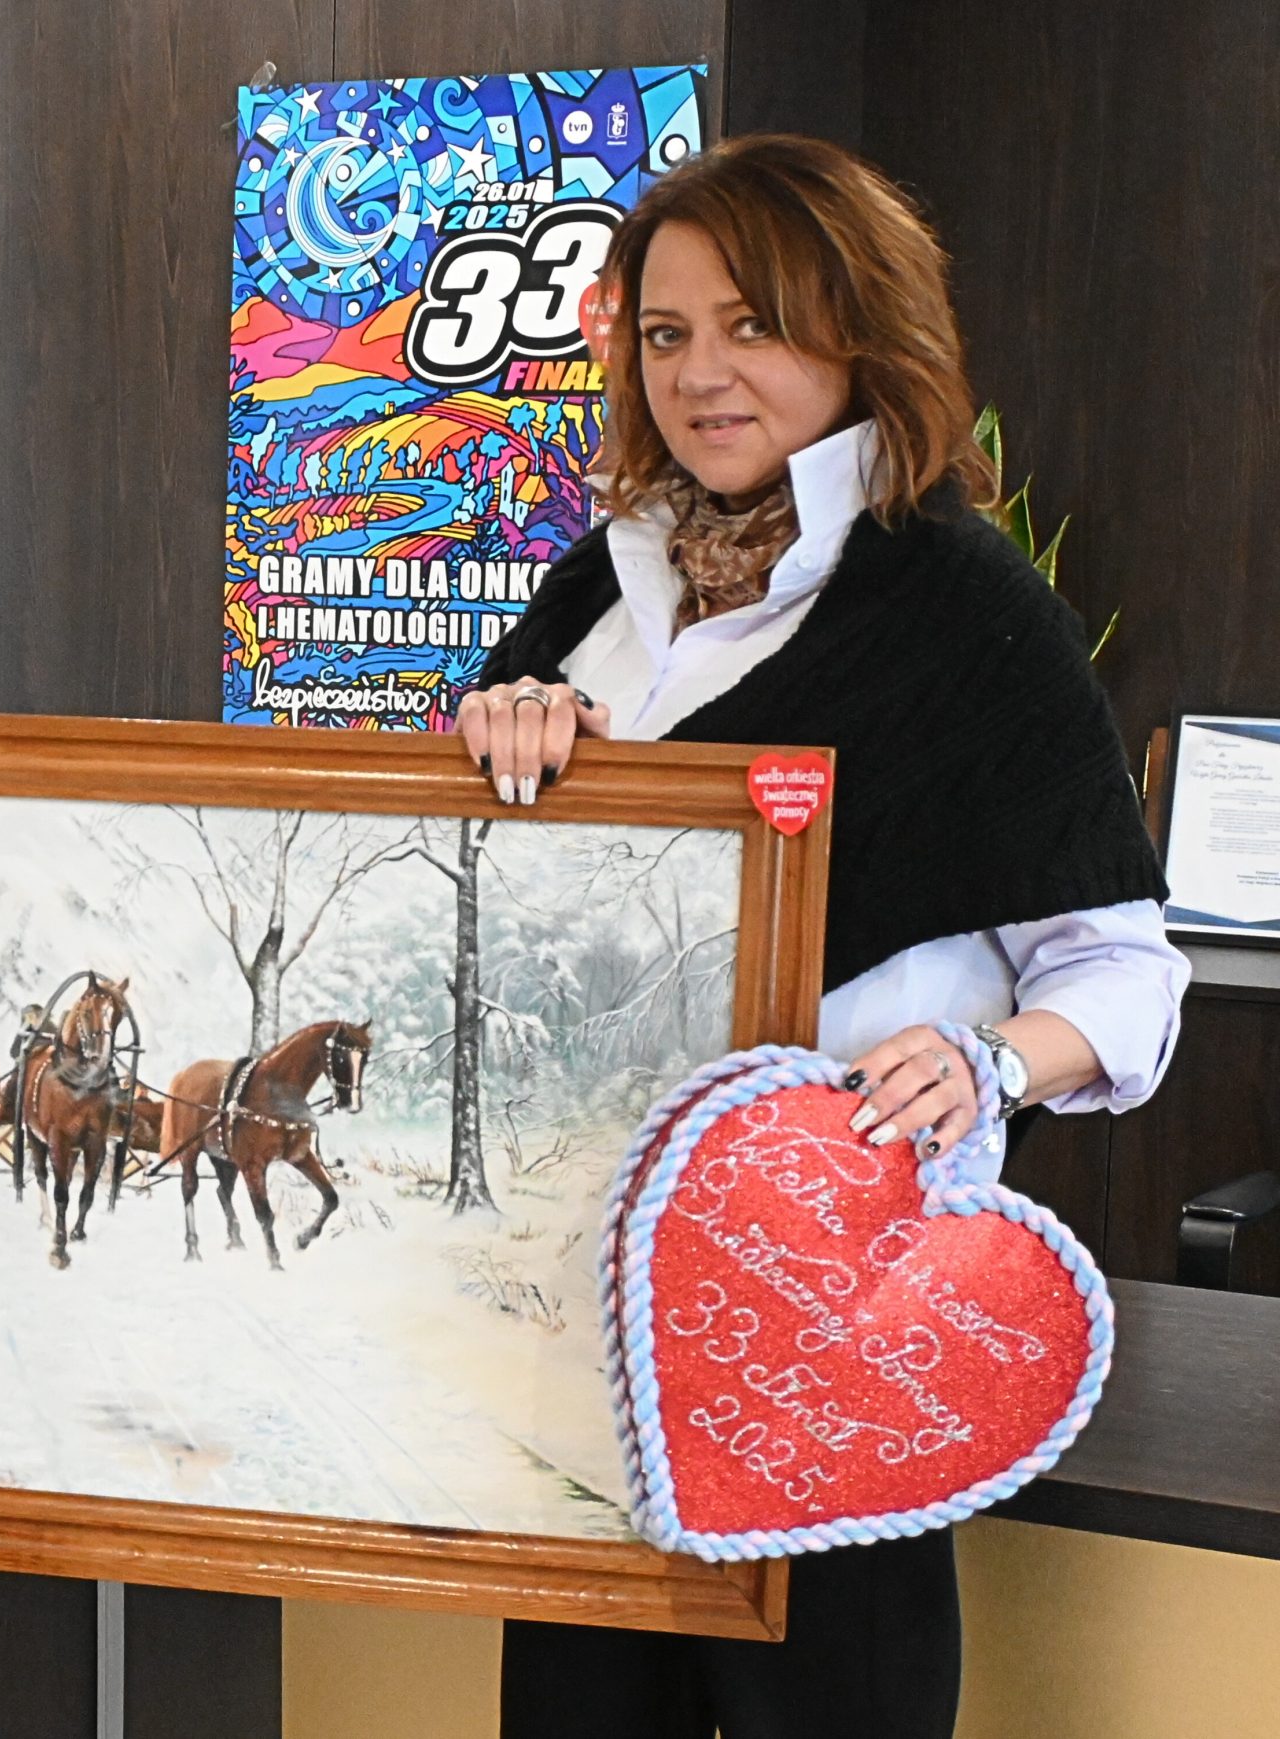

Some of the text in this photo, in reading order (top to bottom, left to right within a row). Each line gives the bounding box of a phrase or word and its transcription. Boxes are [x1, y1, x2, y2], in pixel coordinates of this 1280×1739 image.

[568, 122, 588, 132] tvn
[472, 181, 537, 202] 26.01
[444, 204, 530, 230] 2025
[413, 212, 620, 374] 33
[258, 555, 376, 598] GRAMY
[385, 558, 450, 599] DLA
[257, 606, 268, 639] I
[276, 606, 471, 647] HEMATOLOGII
[439, 682, 448, 712] i
[727, 1100, 883, 1237] Wielka
[666, 1280, 760, 1363] 33
